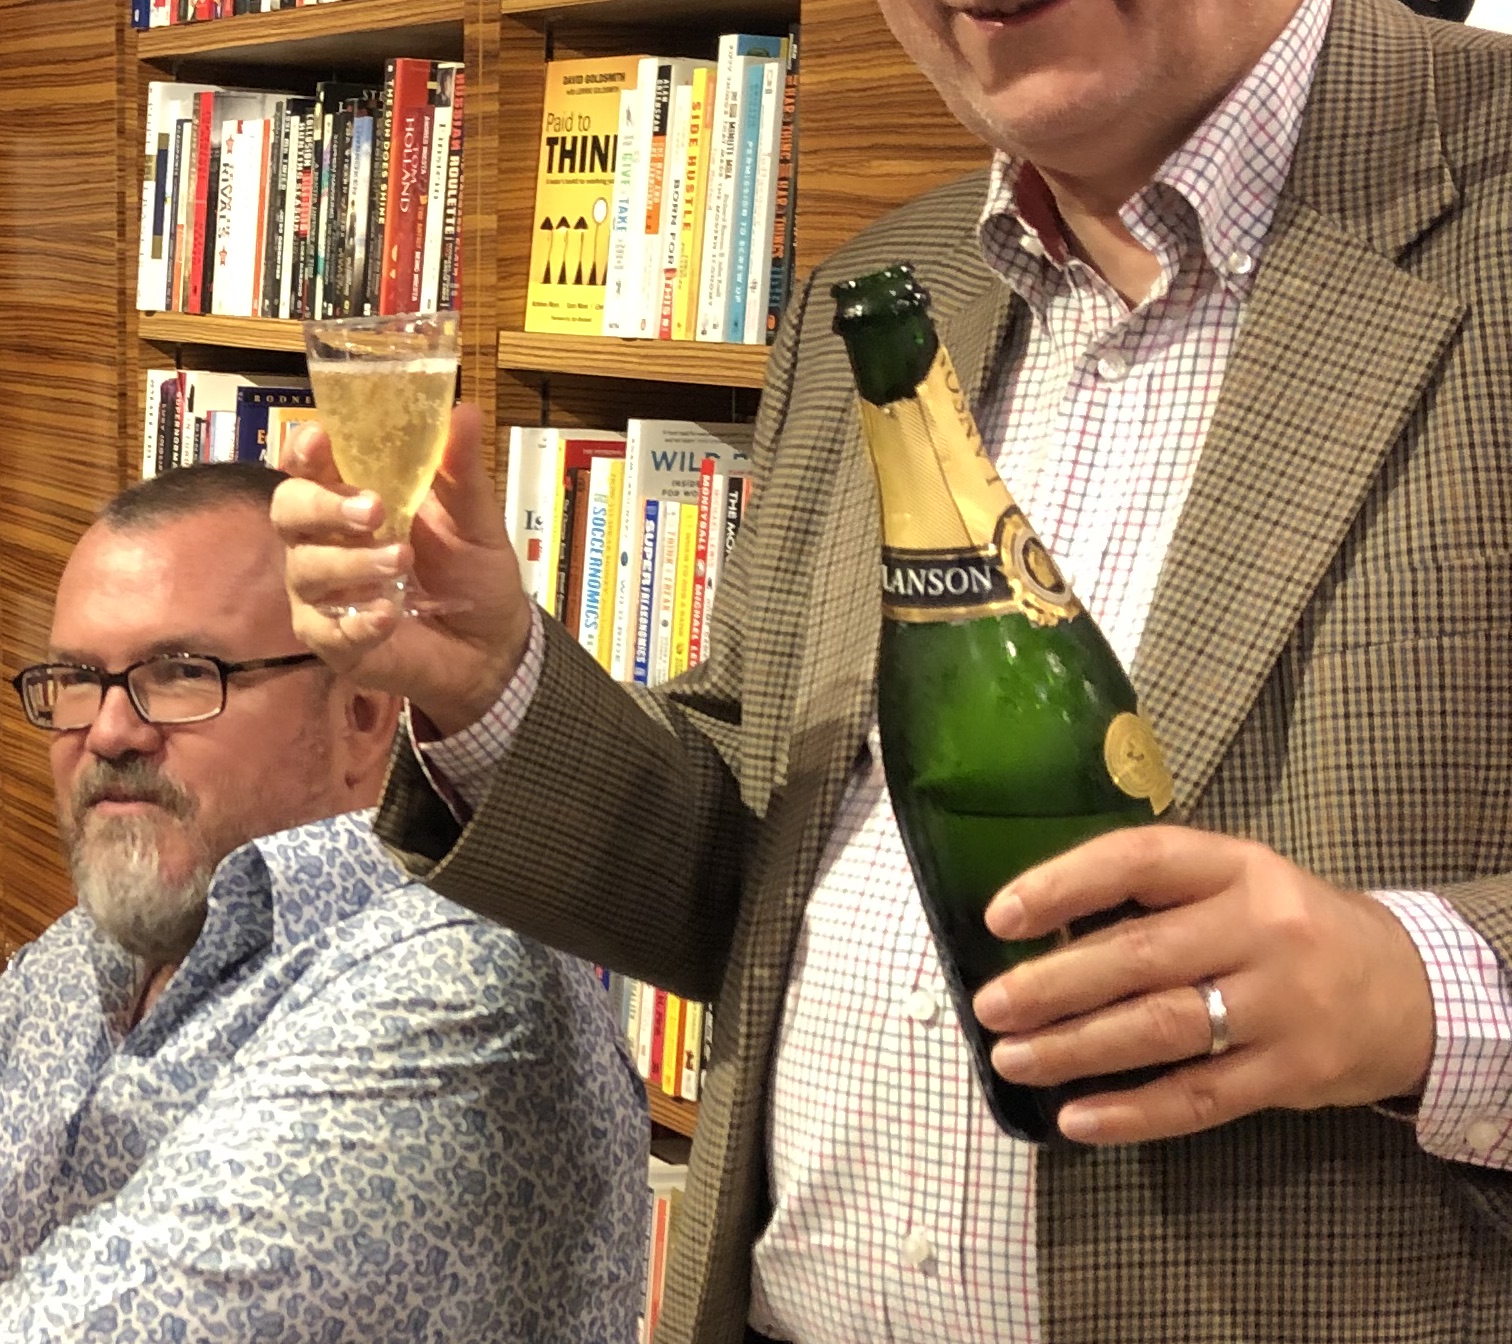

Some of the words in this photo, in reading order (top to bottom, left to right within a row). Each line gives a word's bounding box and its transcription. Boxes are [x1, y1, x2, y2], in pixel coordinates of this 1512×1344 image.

[546, 112, 575, 132] Paid
[578, 114, 591, 132] to
[689, 101, 701, 147] SIDE
[400, 118, 414, 212] HOLLAND
[410, 146, 419, 184] TOM
[670, 179, 680, 225] BORN
[682, 156, 697, 232] HUSTLE
[667, 232, 676, 265] FOR
[584, 506, 607, 629] SOCCERNOMICS
[881, 564, 993, 595] LANSON
